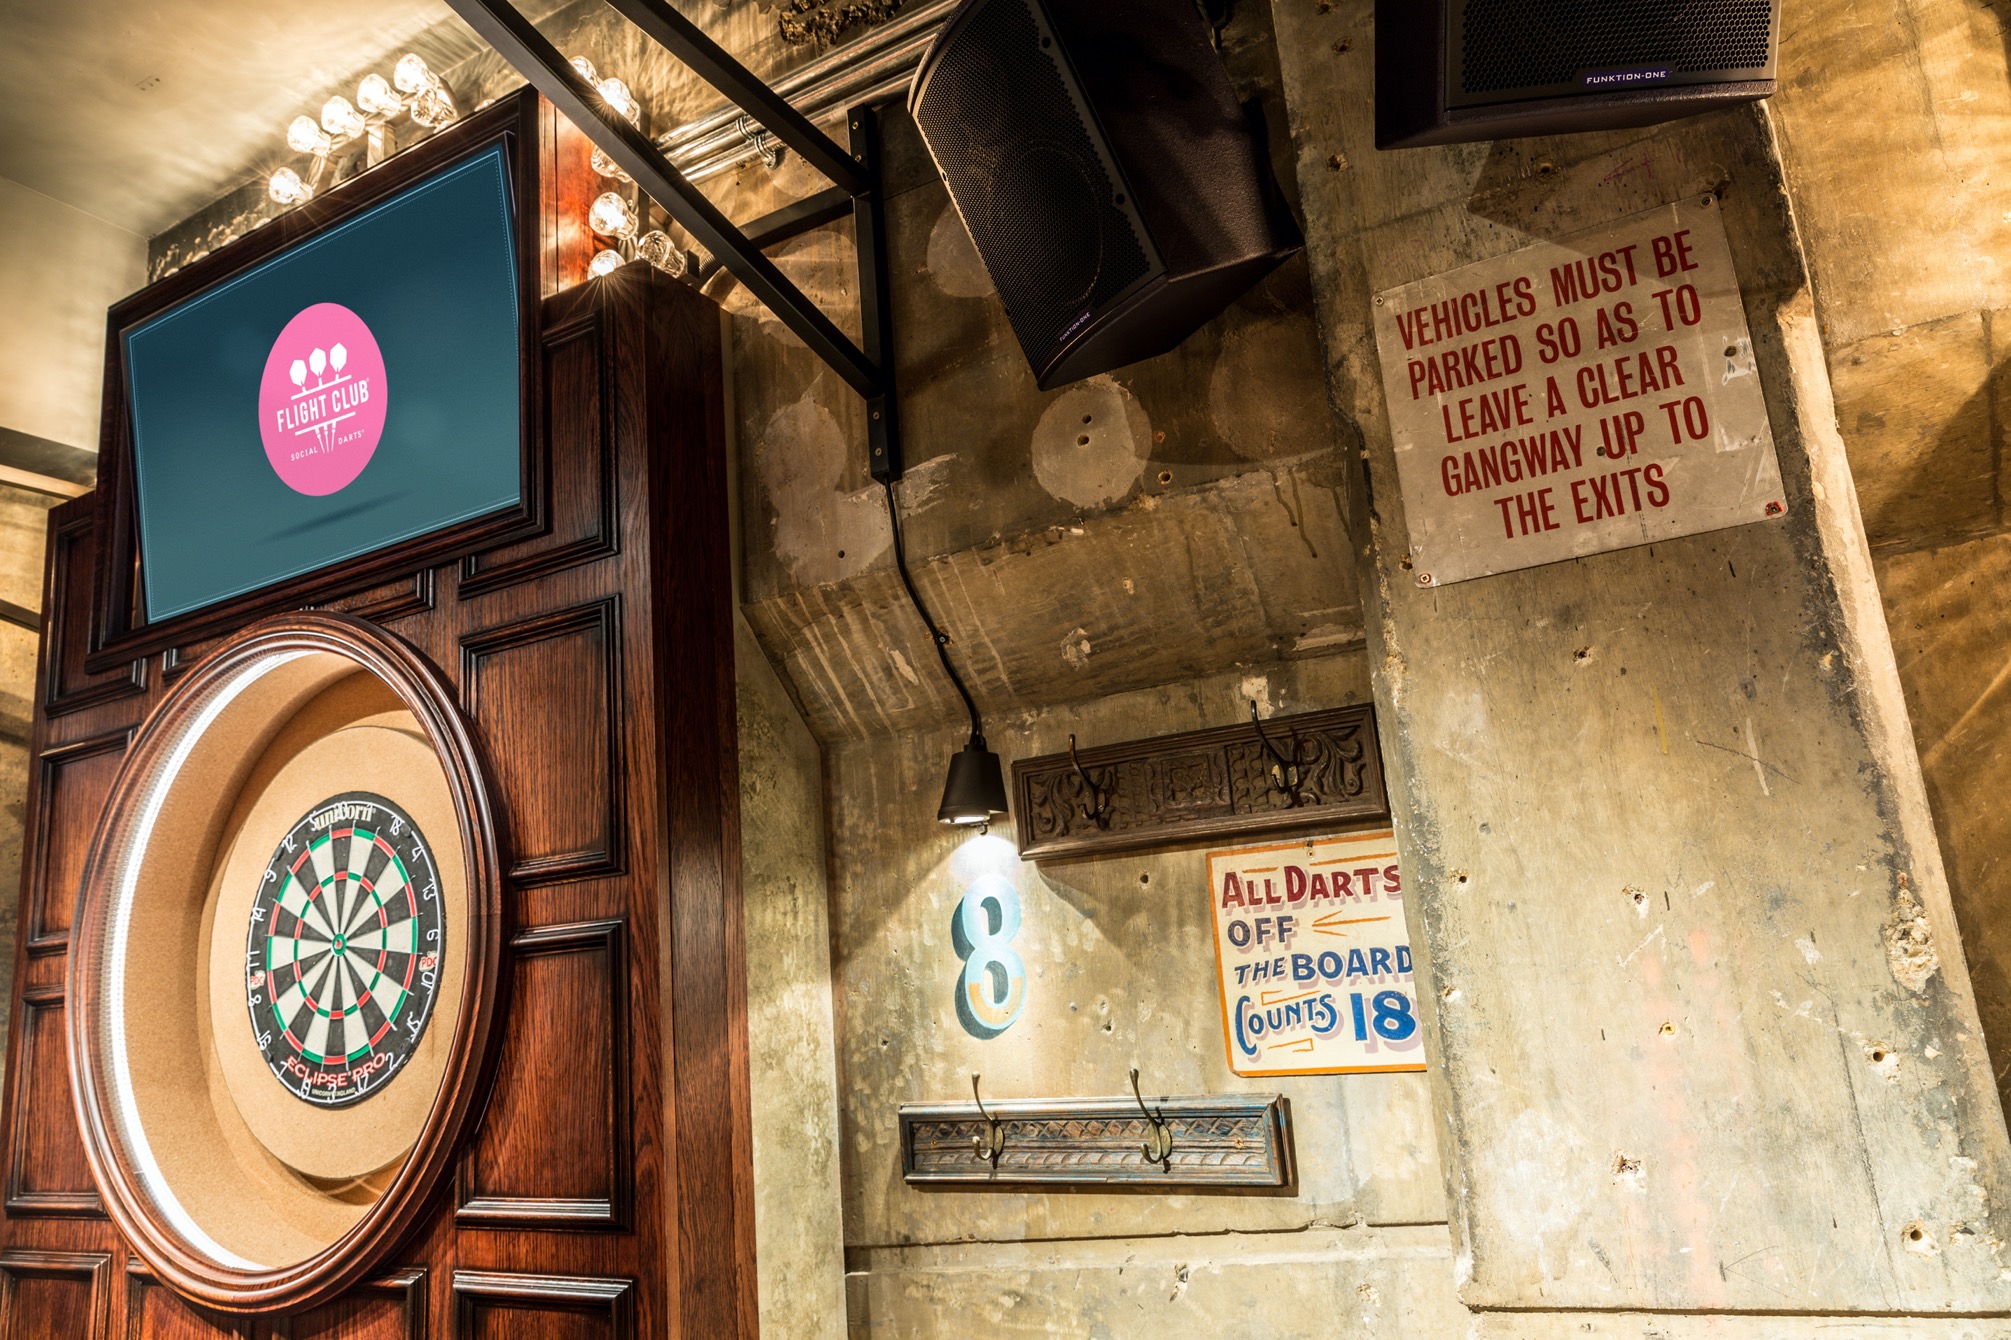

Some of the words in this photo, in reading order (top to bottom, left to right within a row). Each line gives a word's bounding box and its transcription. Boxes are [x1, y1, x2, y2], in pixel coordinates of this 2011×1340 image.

[1586, 71, 1666, 84] FUNKTION-ONE
[1396, 276, 1537, 350] VEHICLES
[1550, 245, 1638, 307] MUST
[1651, 229, 1699, 278] BE
[1408, 333, 1522, 400] PARKED
[1535, 317, 1581, 364] SO
[1597, 301, 1639, 349] AS
[1652, 284, 1702, 332] TO
[276, 394, 327, 433] FLIGHT
[331, 379, 369, 413] CLUB
[1442, 383, 1533, 444] LEAVE
[1546, 376, 1567, 419] A
[1576, 345, 1685, 409] CLEAR
[290, 446, 319, 461] SOCIAL
[338, 431, 363, 445] DARTS
[1441, 424, 1583, 497] GANGWAY
[1600, 411, 1645, 461] UP
[1659, 396, 1709, 445] TO
[1494, 487, 1560, 540] THE
[1570, 463, 1670, 525] EXITS
[389, 813, 405, 835] 18
[281, 833, 297, 853] 12
[411, 845, 424, 862] 4
[264, 868, 276, 883] 9
[422, 878, 437, 900] 13
[1221, 871, 1283, 909] ALL
[1284, 864, 1402, 903] DARTS
[251, 907, 266, 923] 14
[1228, 915, 1294, 947] OFF
[421, 956, 437, 968] PDC
[951, 874, 1027, 1039] 8
[1234, 957, 1286, 984] THE
[1291, 946, 1413, 982] BOARD
[421, 971, 435, 995] 10
[248, 994, 261, 1007] 8
[406, 1011, 420, 1039] 15
[1235, 994, 1337, 1055] COUNTS
[1350, 990, 1416, 1041] 18
[286, 1054, 349, 1087] ECLIPSE
[352, 1052, 385, 1082] PRO
[385, 1052, 398, 1071] 2
